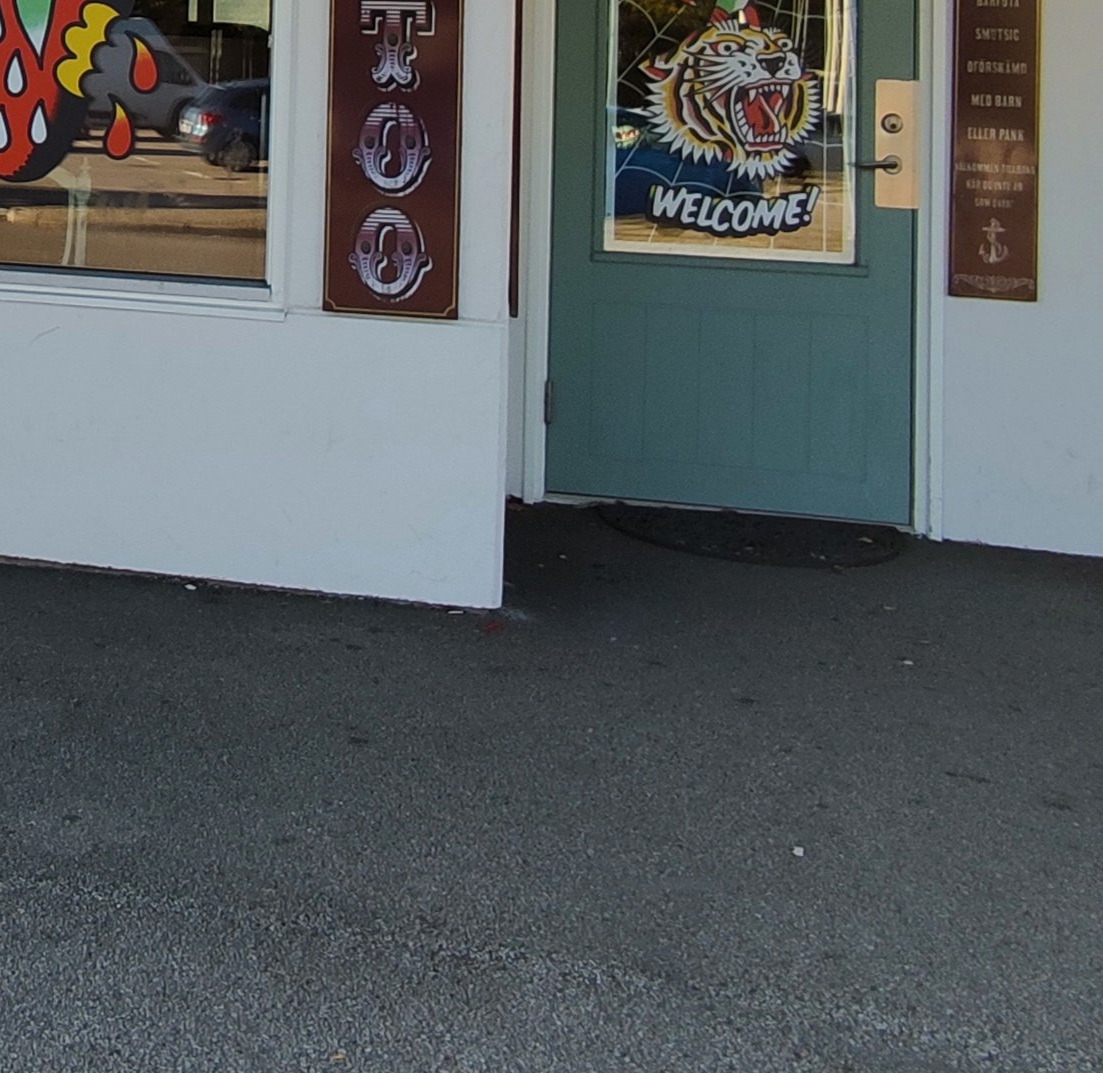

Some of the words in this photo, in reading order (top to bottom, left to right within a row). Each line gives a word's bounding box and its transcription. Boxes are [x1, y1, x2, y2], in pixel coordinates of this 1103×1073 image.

[975, 27, 1020, 41] SMUTSIG
[970, 93, 993, 107] MED
[994, 94, 1023, 108] BARN
[967, 126, 996, 140] ELLER
[998, 128, 1025, 142] PANK
[649, 185, 820, 233] WELCOME!
